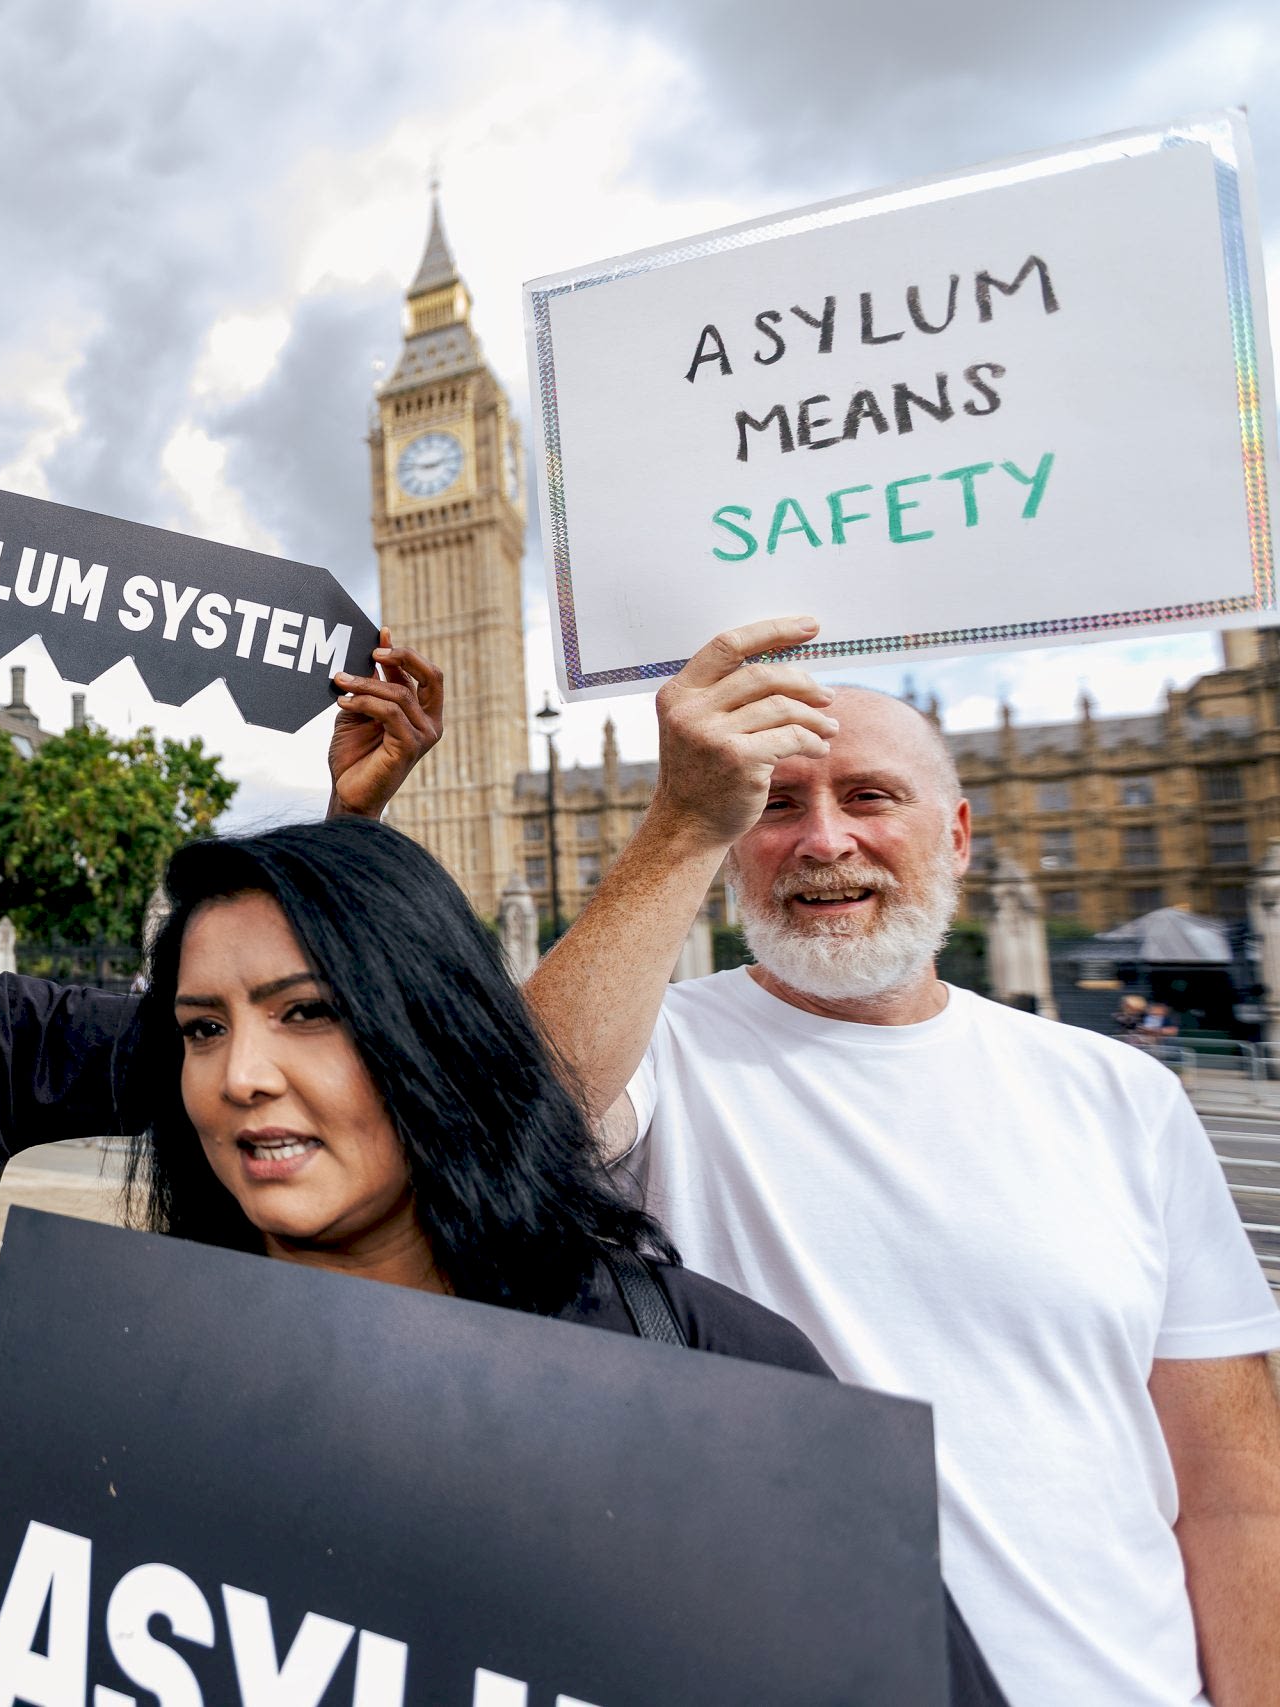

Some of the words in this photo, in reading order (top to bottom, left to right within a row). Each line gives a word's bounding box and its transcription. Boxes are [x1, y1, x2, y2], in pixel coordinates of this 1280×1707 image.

[683, 255, 1059, 384] ASYLUM
[735, 361, 1007, 462] MEANS
[710, 452, 1054, 562] SAFETY
[117, 574, 354, 680] SYSTEM
